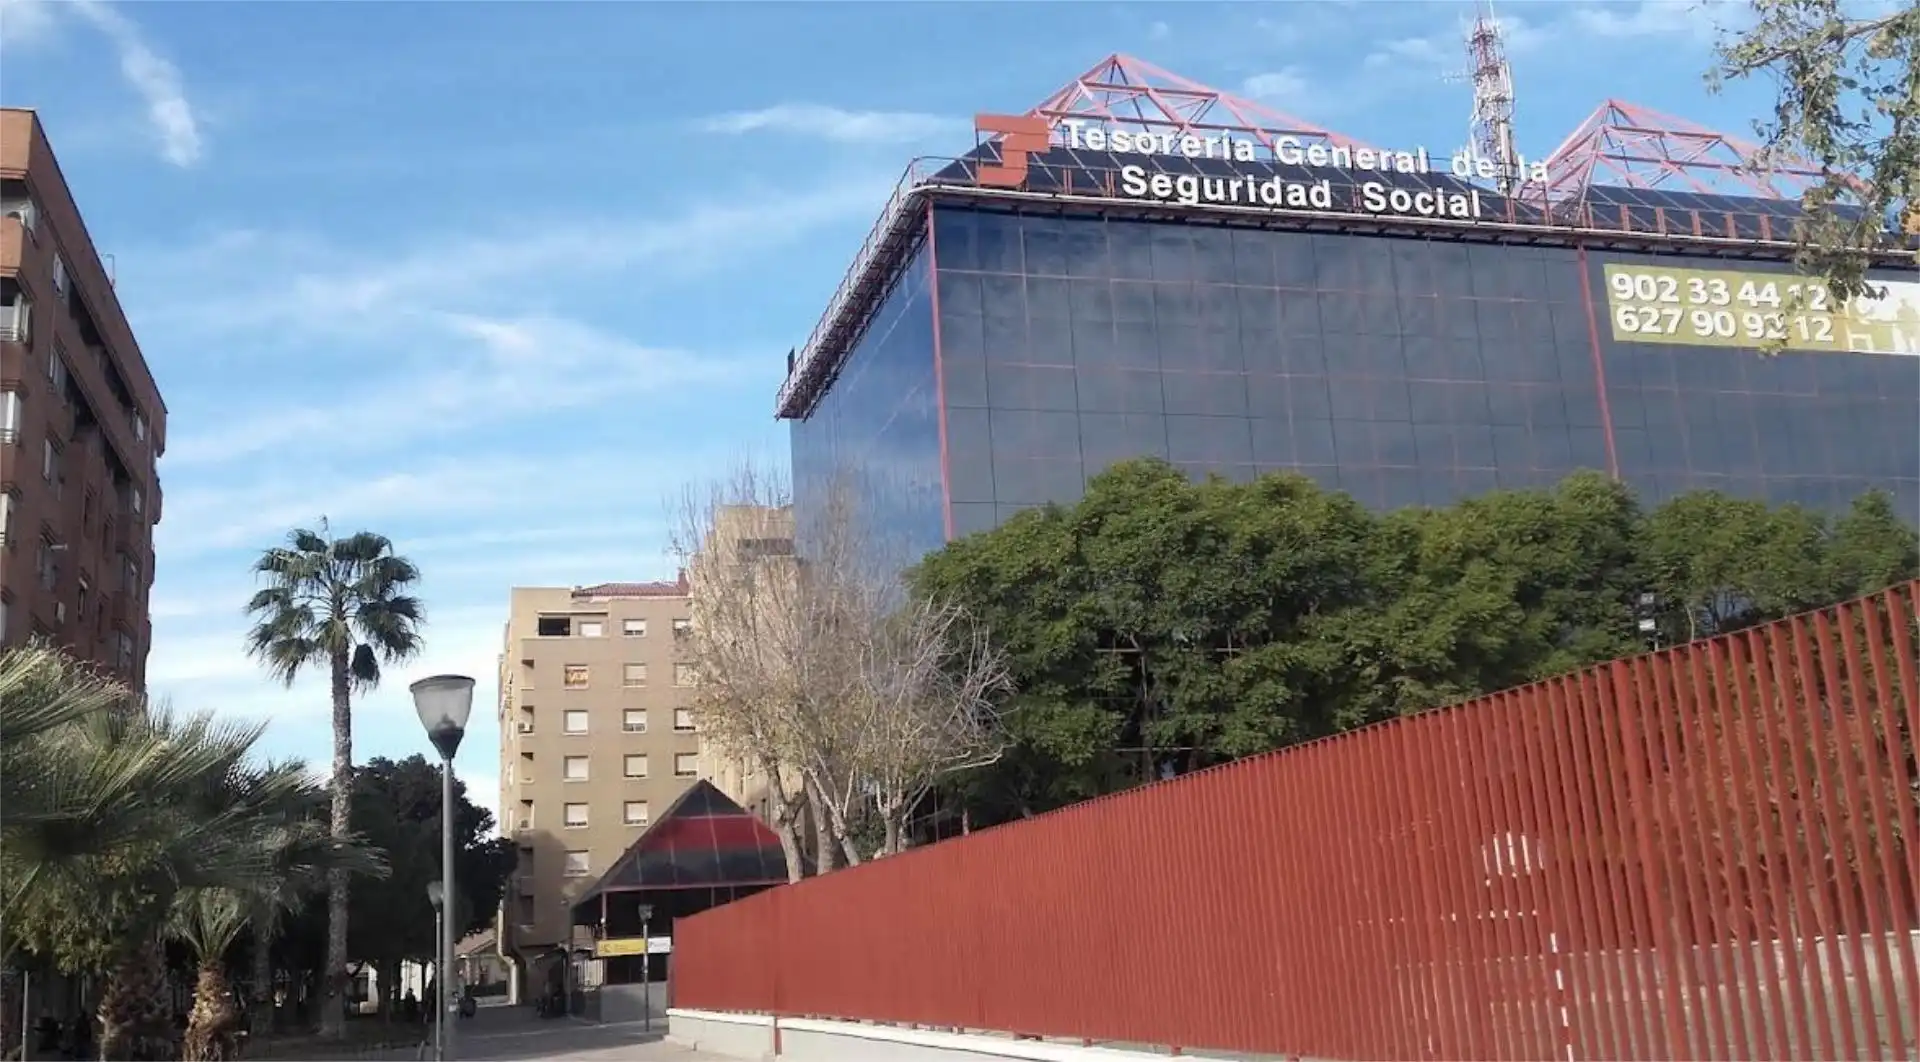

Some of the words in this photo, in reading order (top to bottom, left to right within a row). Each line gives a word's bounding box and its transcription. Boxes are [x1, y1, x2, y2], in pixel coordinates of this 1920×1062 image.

[1062, 118, 1256, 163] Tesorería
[1275, 134, 1430, 174] General
[1451, 144, 1496, 179] de
[1518, 154, 1550, 183] la
[1121, 164, 1333, 209] Seguridad
[1362, 180, 1482, 219] Social
[1611, 273, 1679, 304] 902
[1688, 278, 1731, 306] 33
[1737, 281, 1781, 309] 44
[1787, 284, 1828, 312] 12
[1616, 305, 1684, 335] 627
[1691, 310, 1737, 338] 90
[1794, 315, 1835, 343] 12
